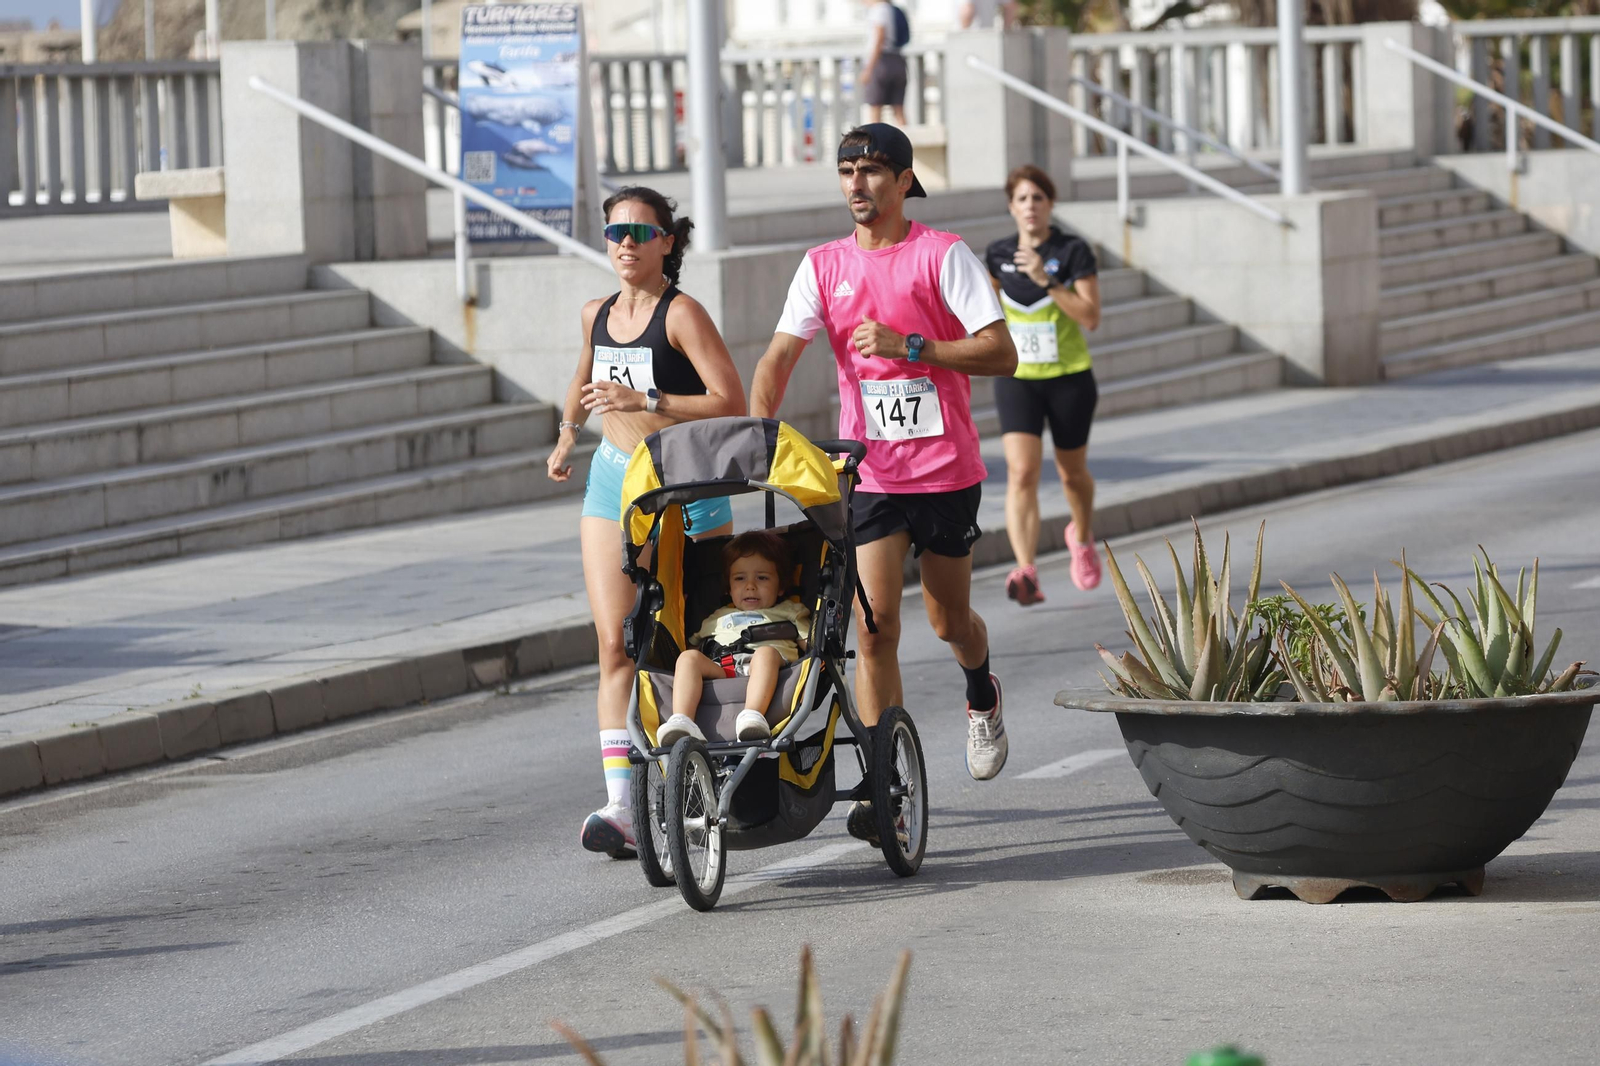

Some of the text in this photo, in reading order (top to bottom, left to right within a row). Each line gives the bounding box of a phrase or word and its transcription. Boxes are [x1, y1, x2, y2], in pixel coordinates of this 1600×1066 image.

[464, 4, 576, 24] TURMARES
[498, 44, 541, 59] Tarifa
[1021, 334, 1040, 353] 28
[609, 365, 635, 390] 51
[889, 383, 906, 397] ELA
[905, 382, 929, 394] TARIFA
[875, 396, 921, 427] 147
